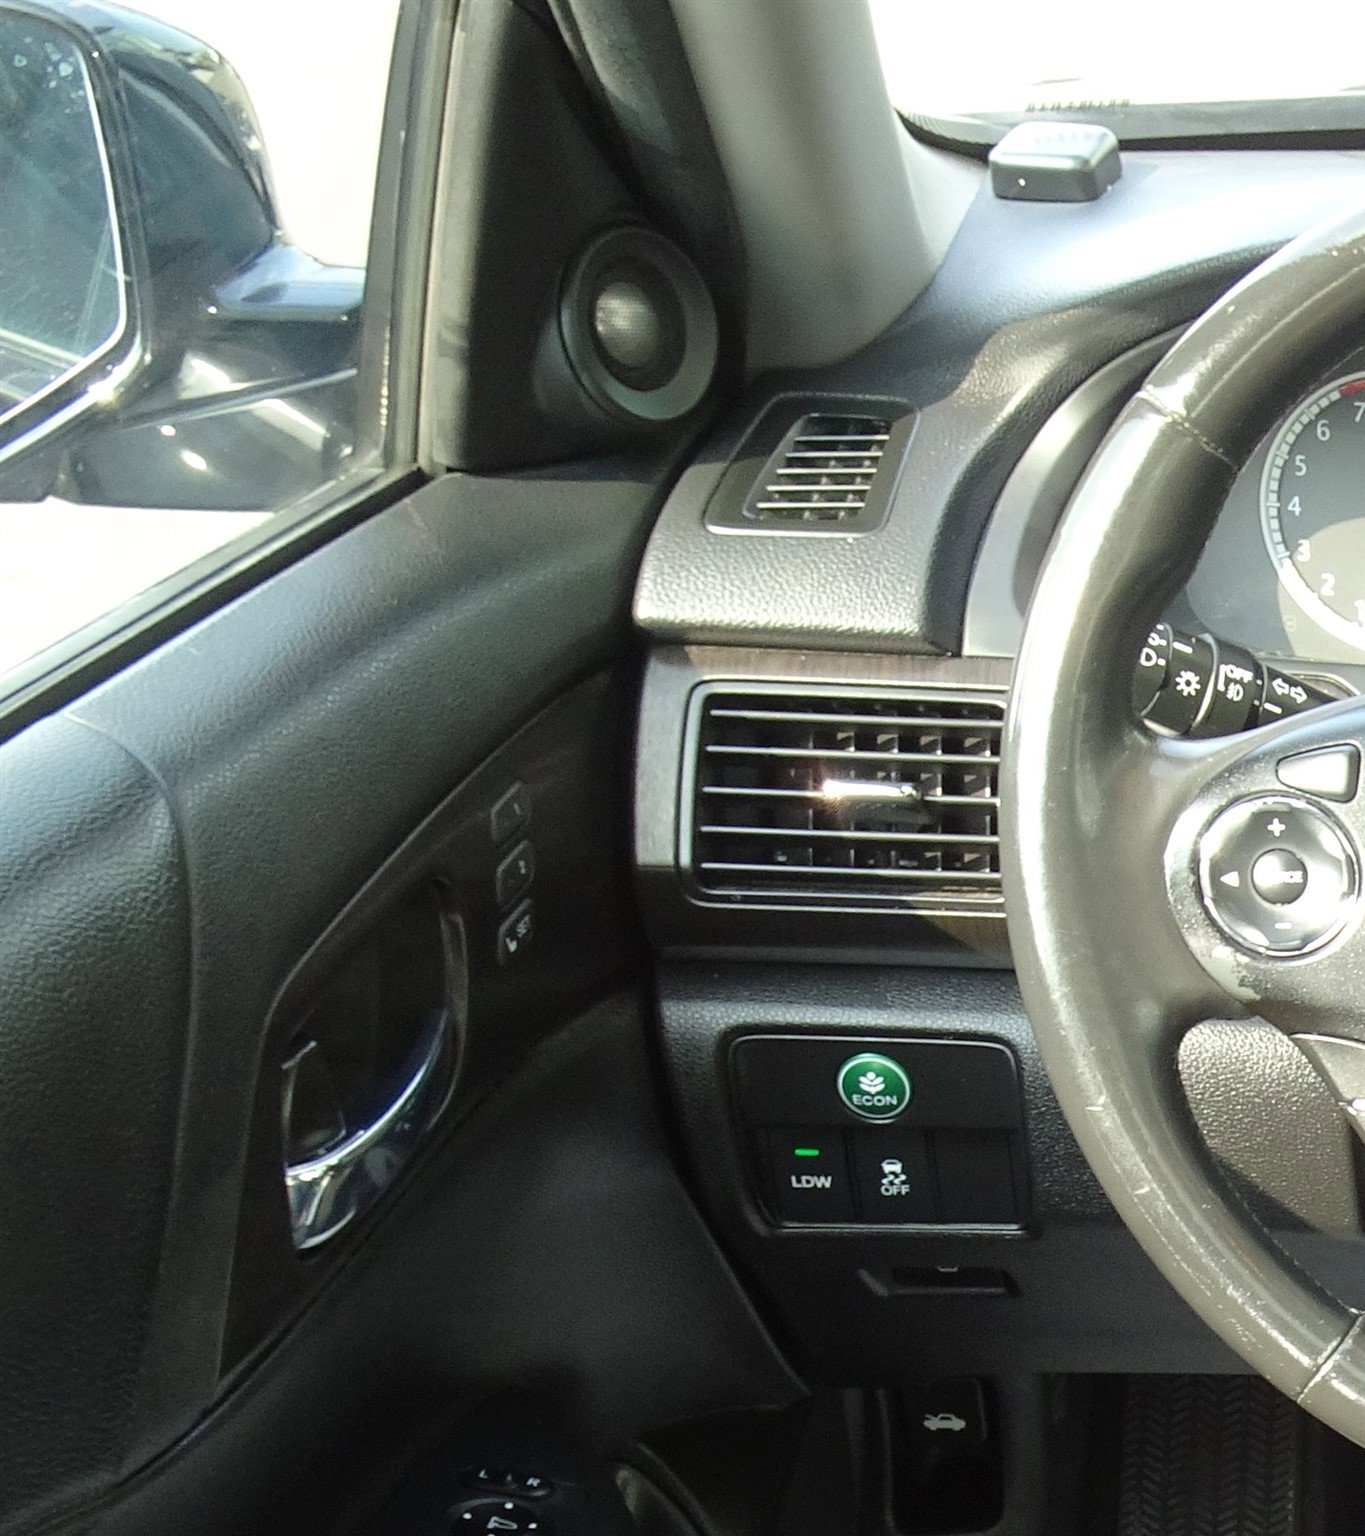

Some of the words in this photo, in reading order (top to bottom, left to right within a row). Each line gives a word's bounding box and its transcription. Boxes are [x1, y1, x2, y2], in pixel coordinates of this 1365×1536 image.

[1316, 419, 1331, 442] 6
[1294, 454, 1308, 477] 5
[1287, 495, 1302, 517] 4
[1297, 539, 1312, 562] 3
[1319, 572, 1336, 597] 2
[1226, 664, 1254, 683] OFF
[851, 1094, 899, 1107] ECON
[790, 1174, 833, 1189] LDW
[880, 1184, 911, 1197] OFF
[526, 1476, 541, 1488] R
